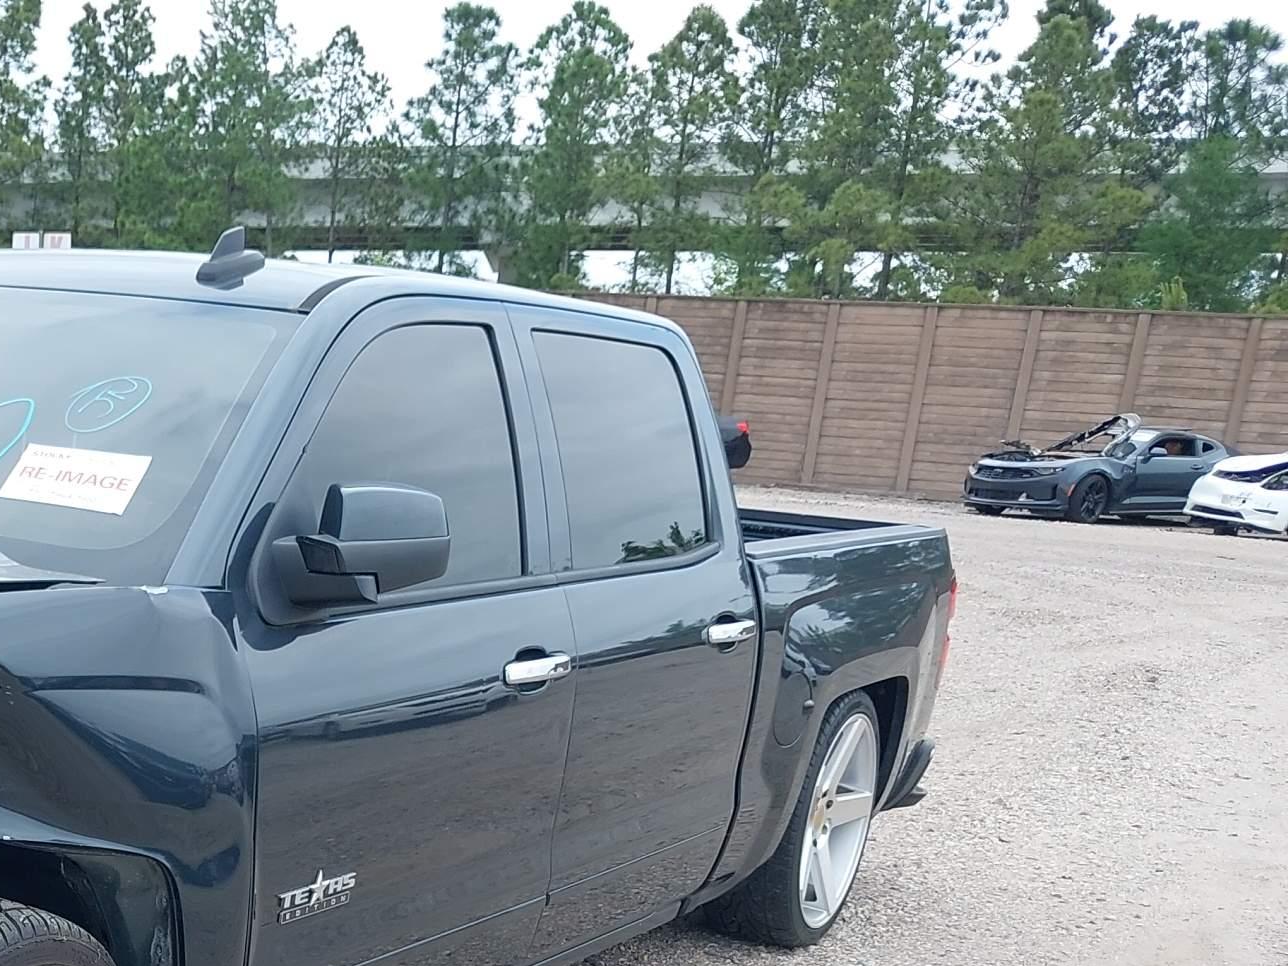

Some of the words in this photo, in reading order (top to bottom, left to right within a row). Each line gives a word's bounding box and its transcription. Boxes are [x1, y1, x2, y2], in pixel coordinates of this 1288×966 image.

[19, 466, 133, 492] RE-IMAGE
[277, 869, 358, 909] TEXAS
[284, 895, 347, 921] EDITION
